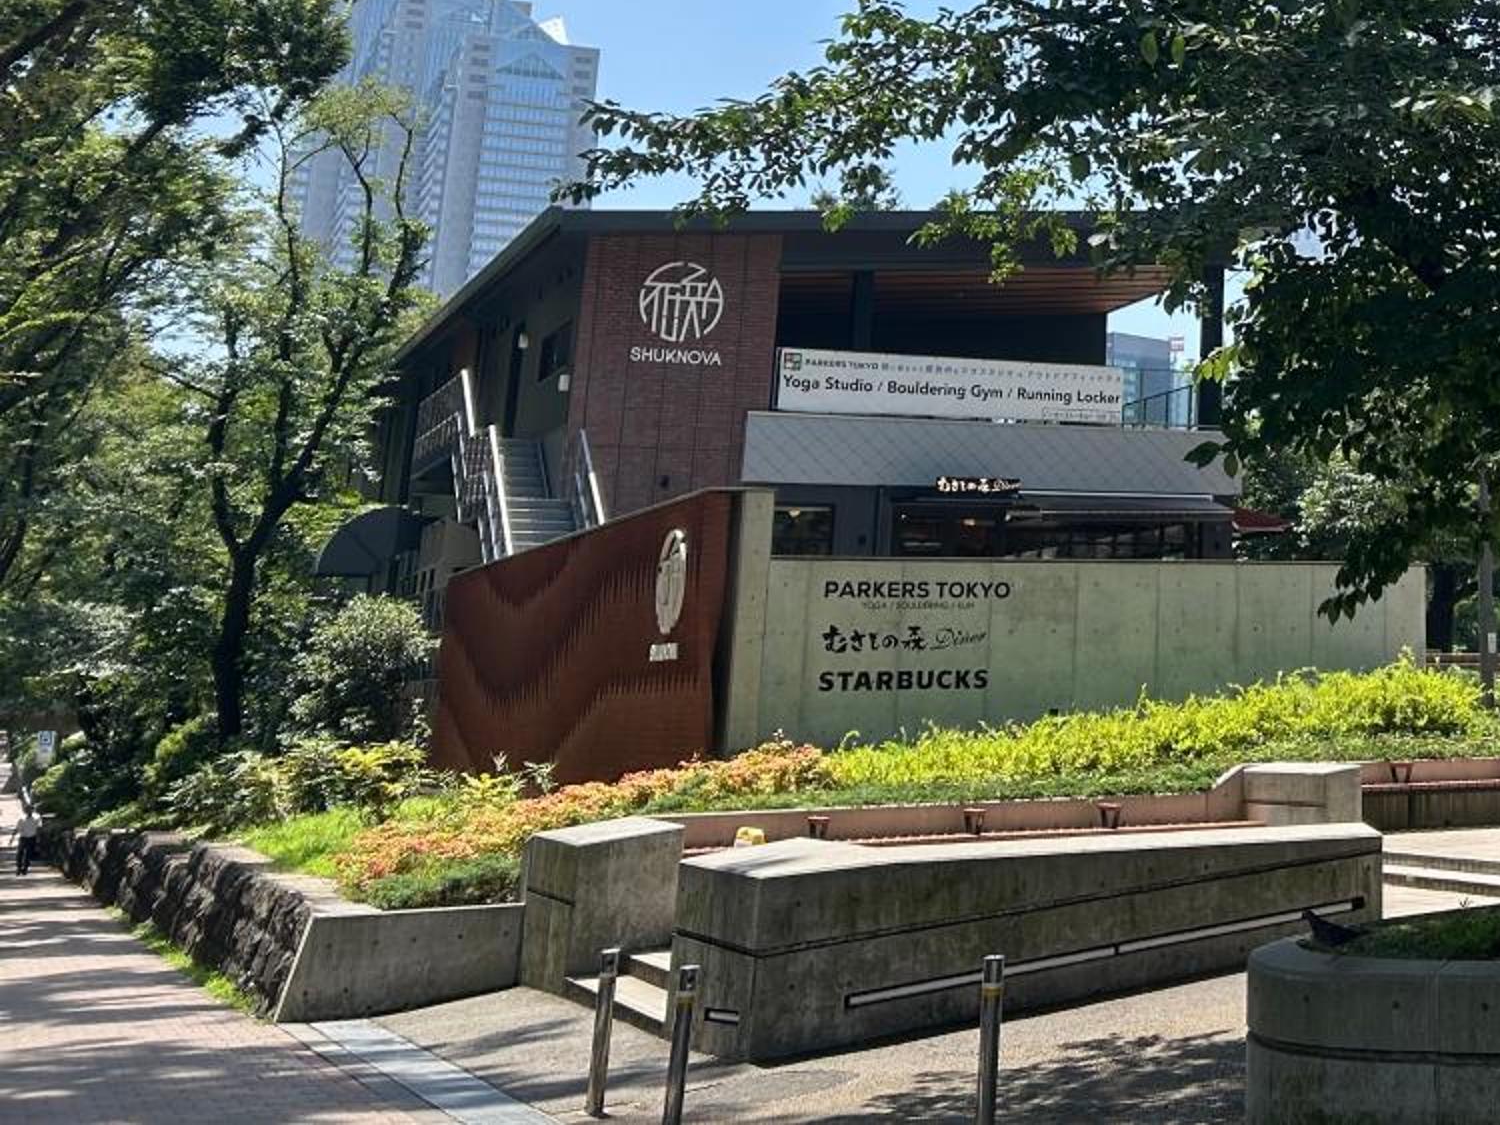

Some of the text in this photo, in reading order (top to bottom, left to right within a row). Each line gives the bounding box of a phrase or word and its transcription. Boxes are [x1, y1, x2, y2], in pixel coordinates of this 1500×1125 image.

[630, 346, 721, 365] SHUKNOVA
[805, 358, 847, 369] PARKERS
[783, 375, 820, 392] Yoga
[825, 376, 873, 392] Studio
[887, 380, 966, 400] Bouldering
[971, 384, 1003, 401] Gym
[1017, 387, 1073, 405] Running
[1077, 390, 1120, 404] Locker
[824, 581, 1011, 598] PARKERS TOKYO
[822, 625, 928, 653] むさしの森
[818, 669, 989, 692] STARBUCKS
